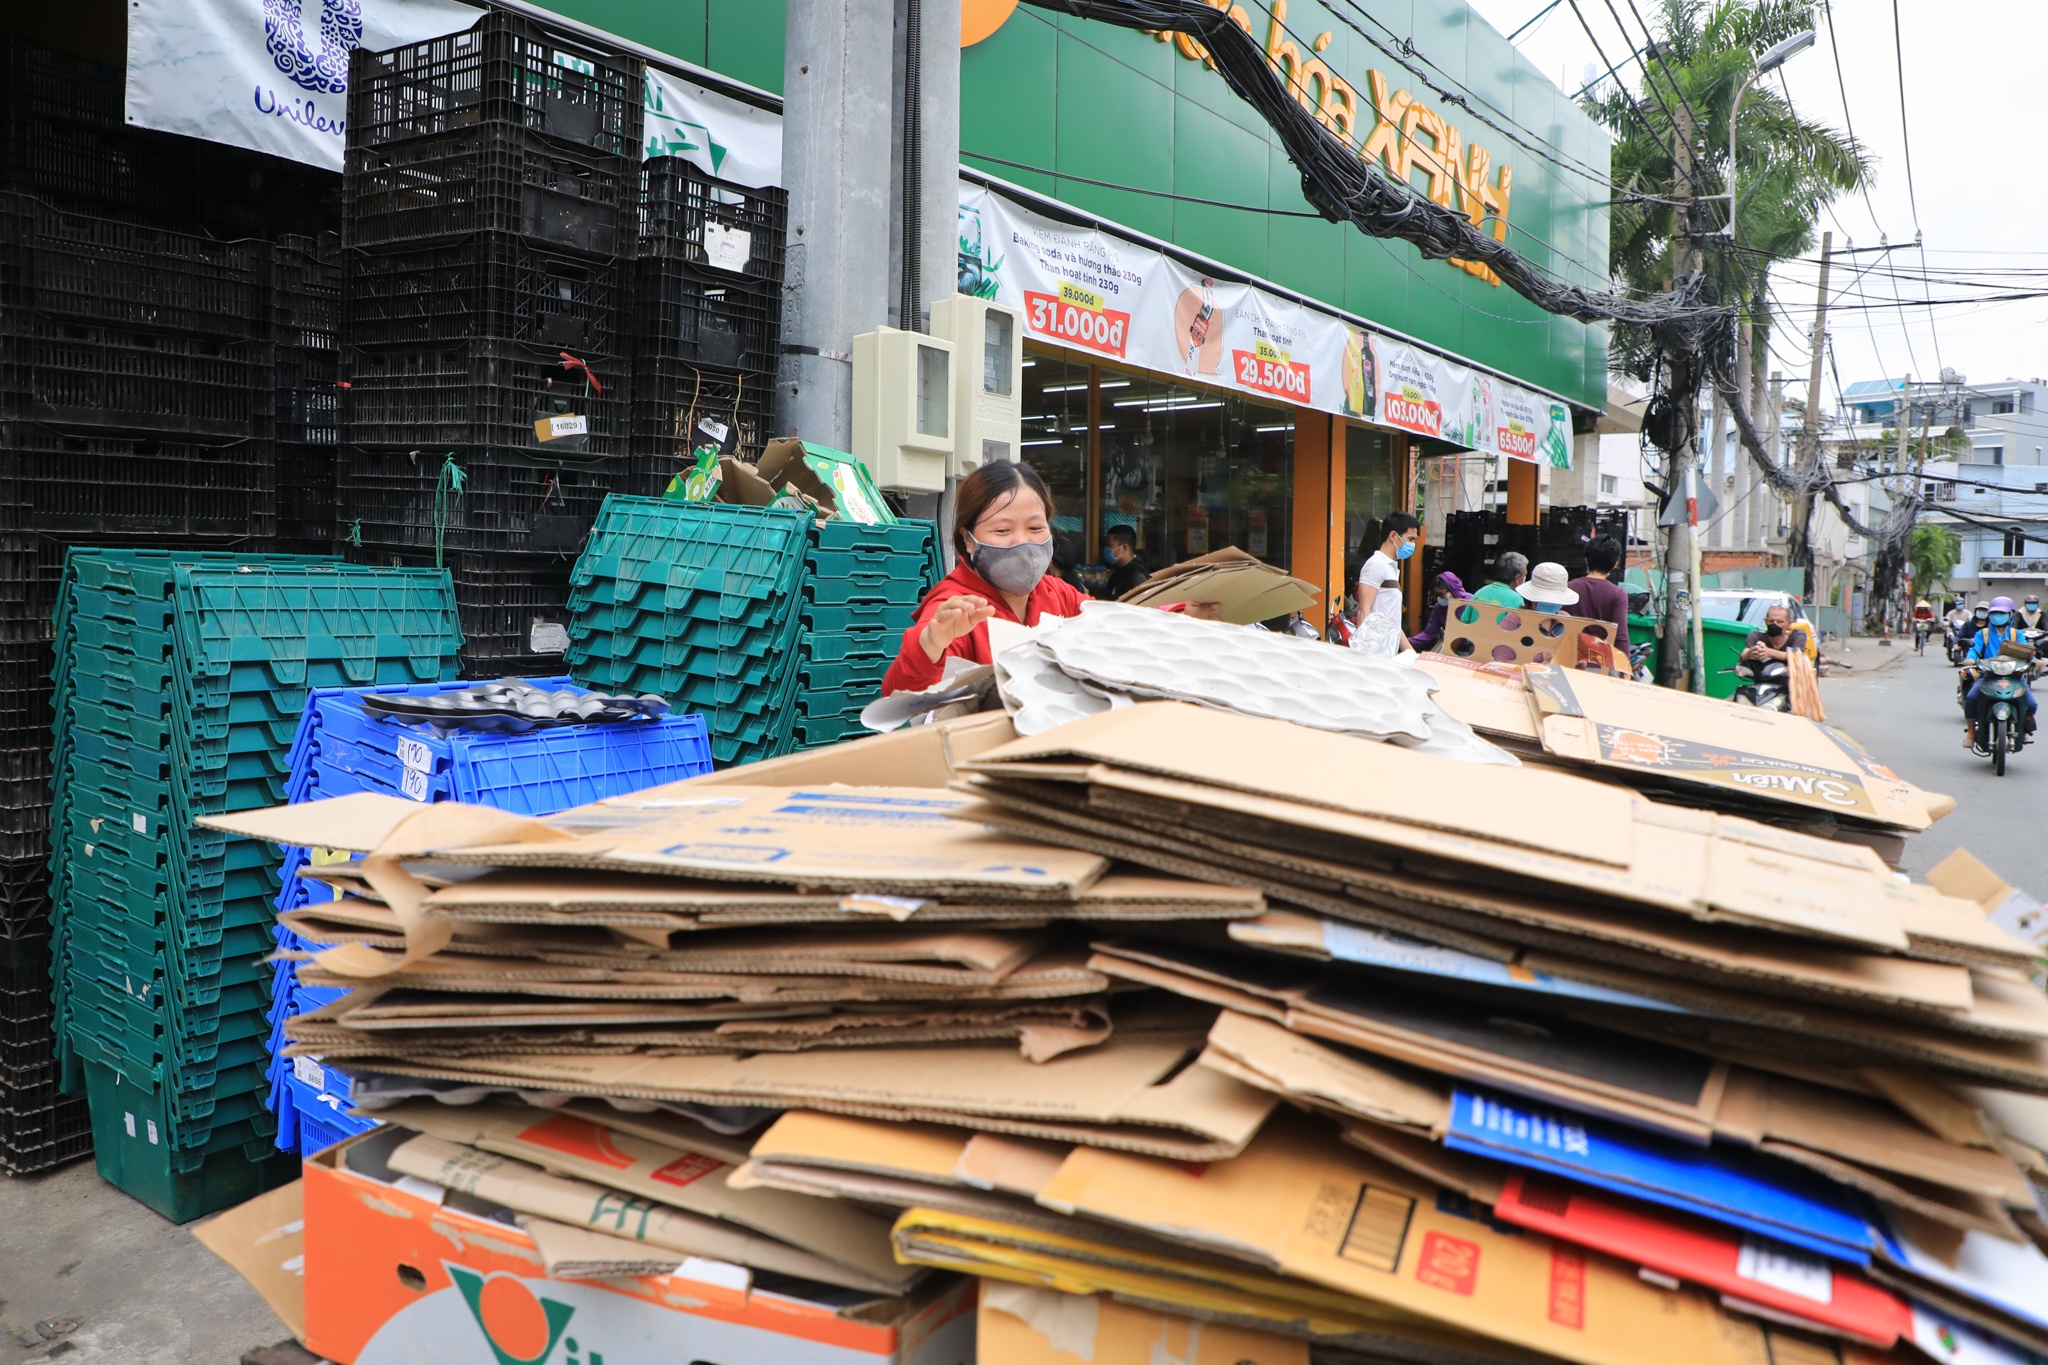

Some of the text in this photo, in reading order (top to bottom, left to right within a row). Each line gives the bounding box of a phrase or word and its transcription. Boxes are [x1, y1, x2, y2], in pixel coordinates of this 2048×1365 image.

[1359, 68, 1513, 247] XANH
[1013, 231, 1142, 287] Baking soda và hương thảo 230g
[1040, 258, 1061, 275] Than
[1062, 265, 1082, 283] hoạt
[1098, 278, 1119, 295] 230g
[1063, 286, 1095, 306] 39.000đ
[1031, 297, 1124, 349] 31.000đ
[1240, 356, 1306, 395] 29.500đ
[1386, 398, 1440, 430] 103.000đ
[1500, 430, 1534, 456] 65.500đ
